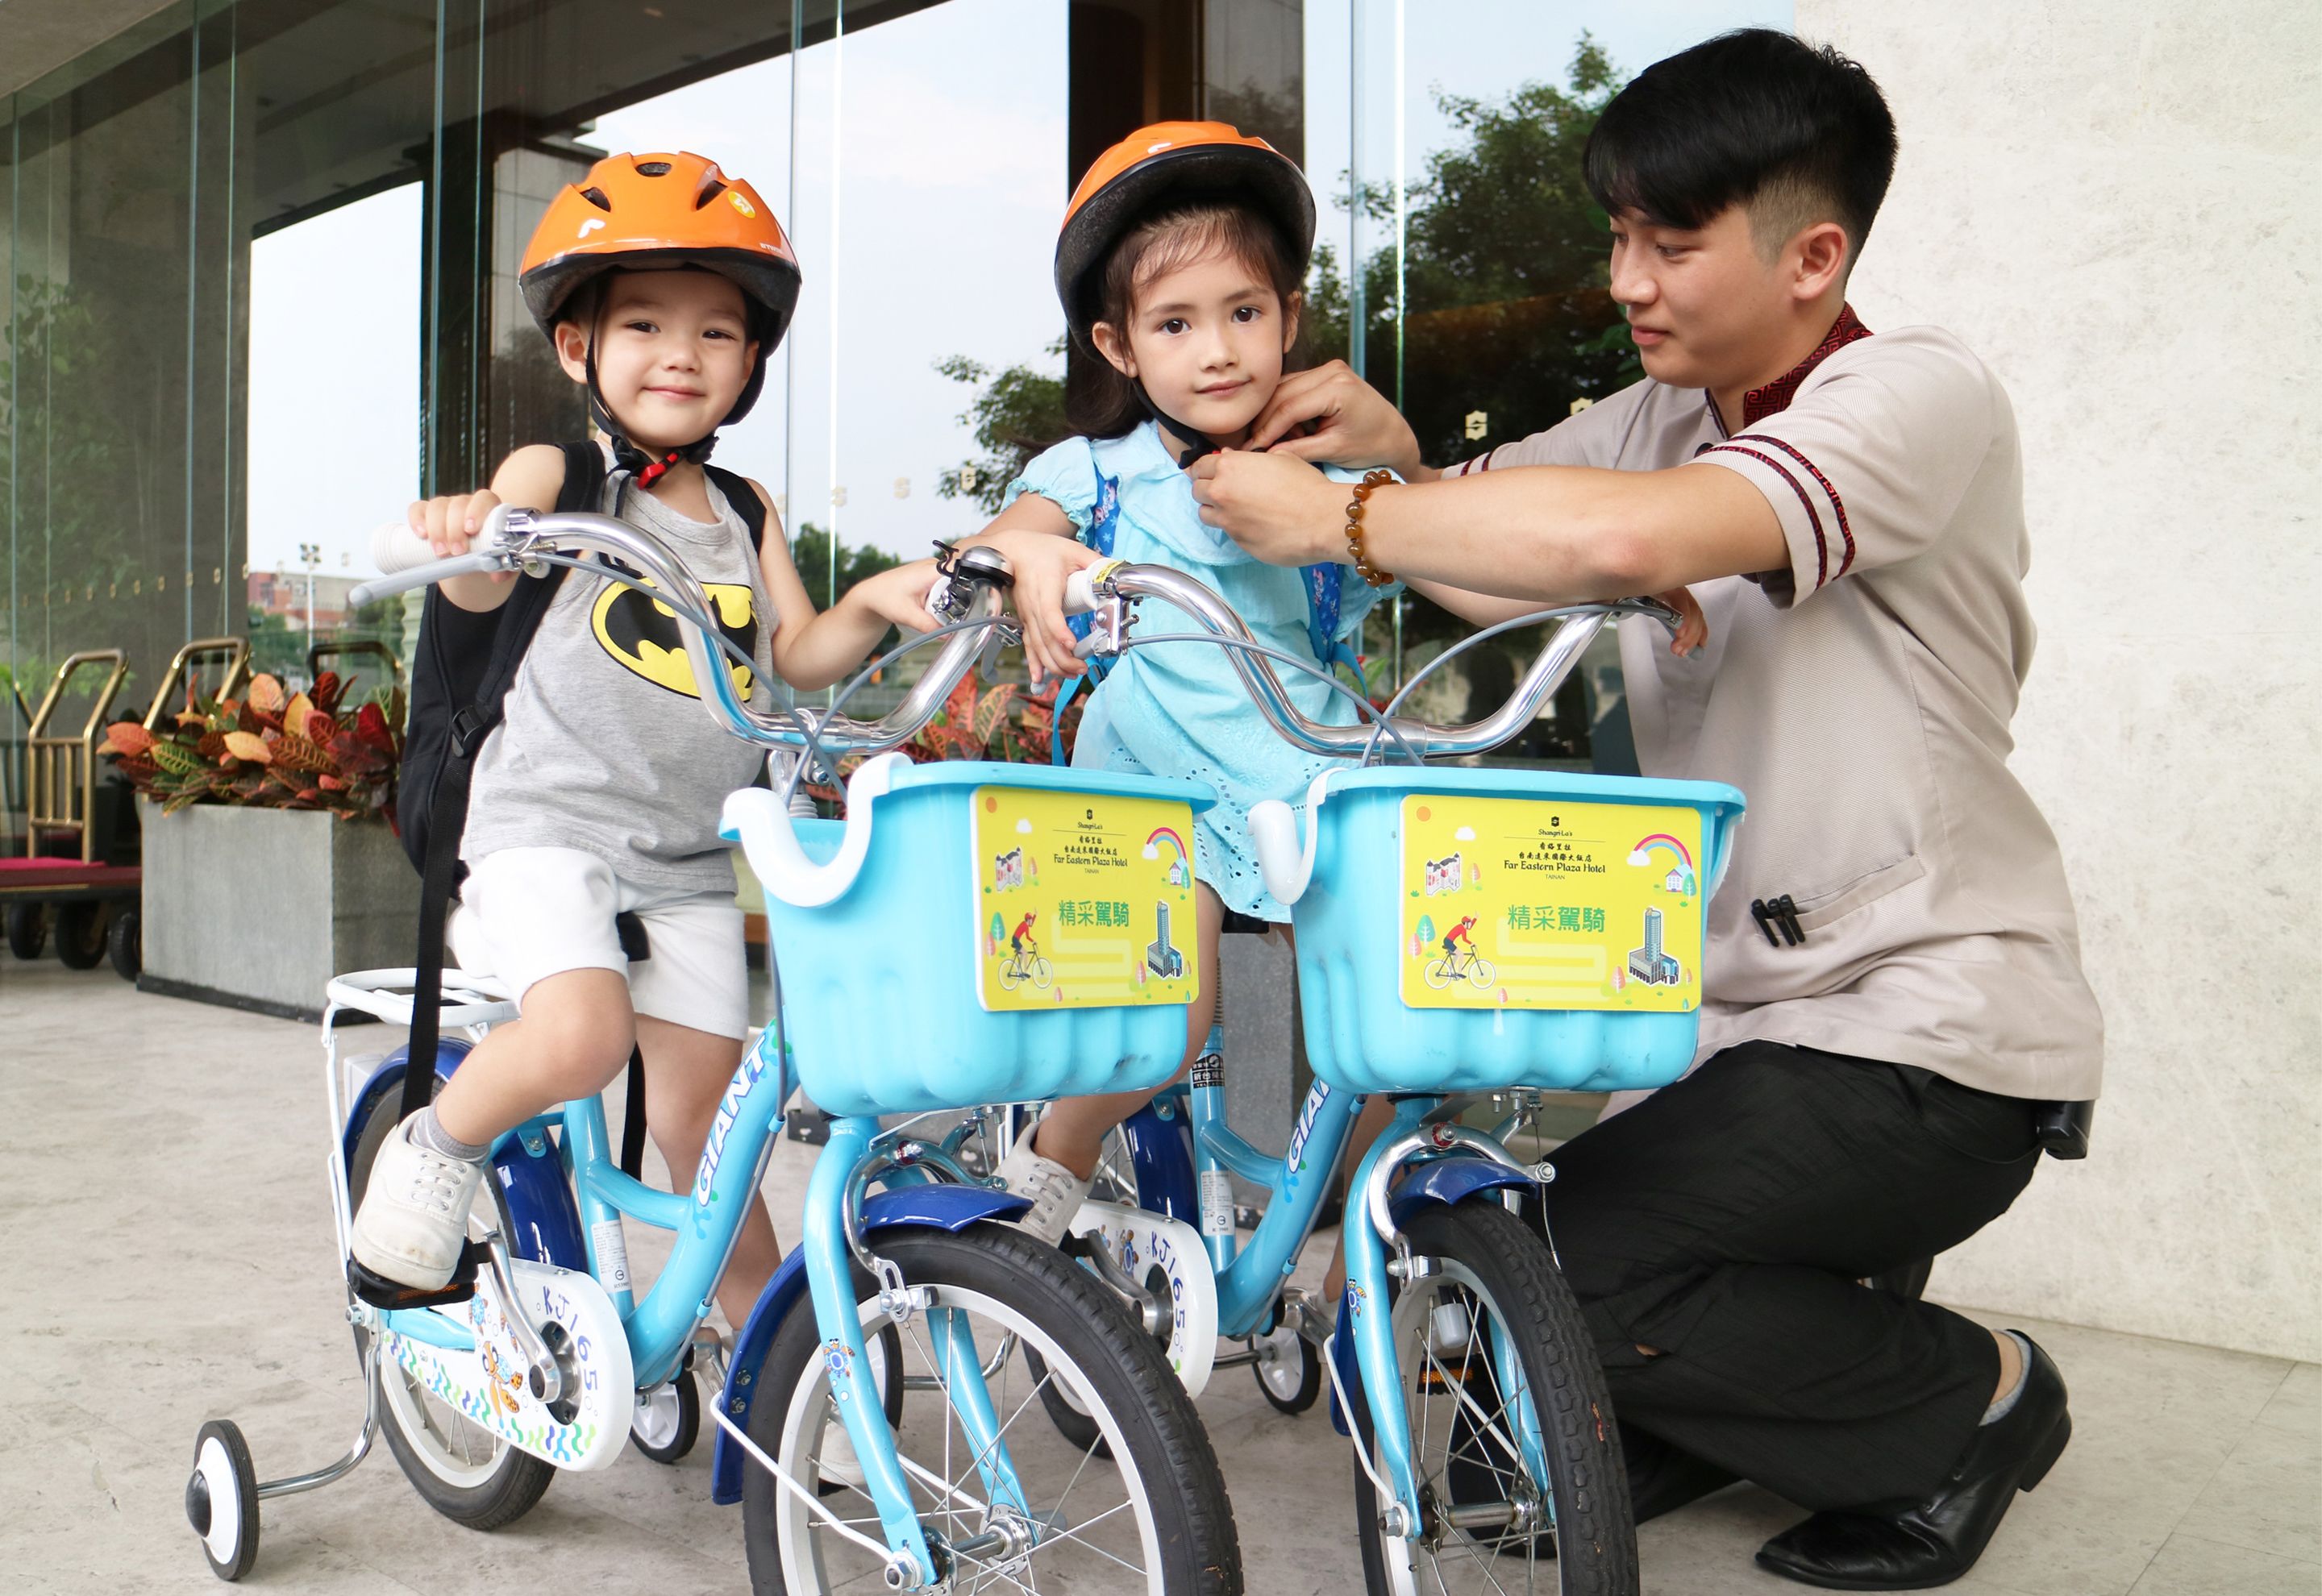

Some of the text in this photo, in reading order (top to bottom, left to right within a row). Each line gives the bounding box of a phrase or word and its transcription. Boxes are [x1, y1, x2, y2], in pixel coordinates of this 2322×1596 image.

[1054, 854, 1128, 867] Far Eastern Plaza Hotel
[1504, 860, 1606, 873] Far Eastern Plaza Hotel
[1059, 900, 1130, 928] 精采駕騎
[1507, 904, 1605, 933] 精采駕騎
[696, 1034, 767, 1207] GIANT
[1151, 1231, 1185, 1328] KJ165
[543, 1285, 598, 1390] KJ165
